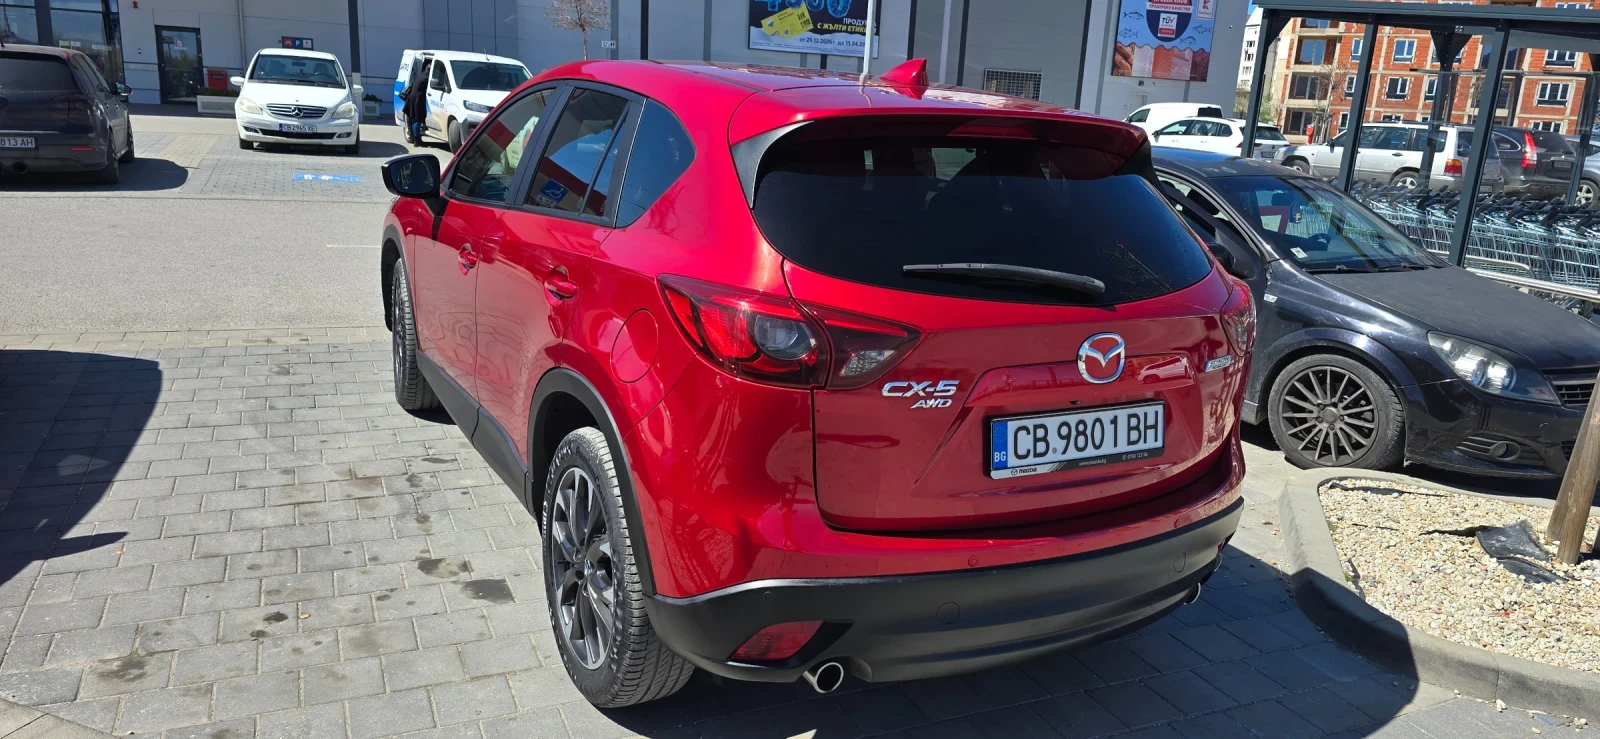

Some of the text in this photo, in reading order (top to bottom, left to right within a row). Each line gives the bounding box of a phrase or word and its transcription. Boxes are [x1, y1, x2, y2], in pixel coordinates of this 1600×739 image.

[822, 23, 846, 31] ЖЪЛТИ
[882, 380, 960, 397] CX-5
[910, 398, 952, 409] AWD
[1014, 410, 1159, 460] CB 9801 BH
[994, 451, 1006, 462] BG
